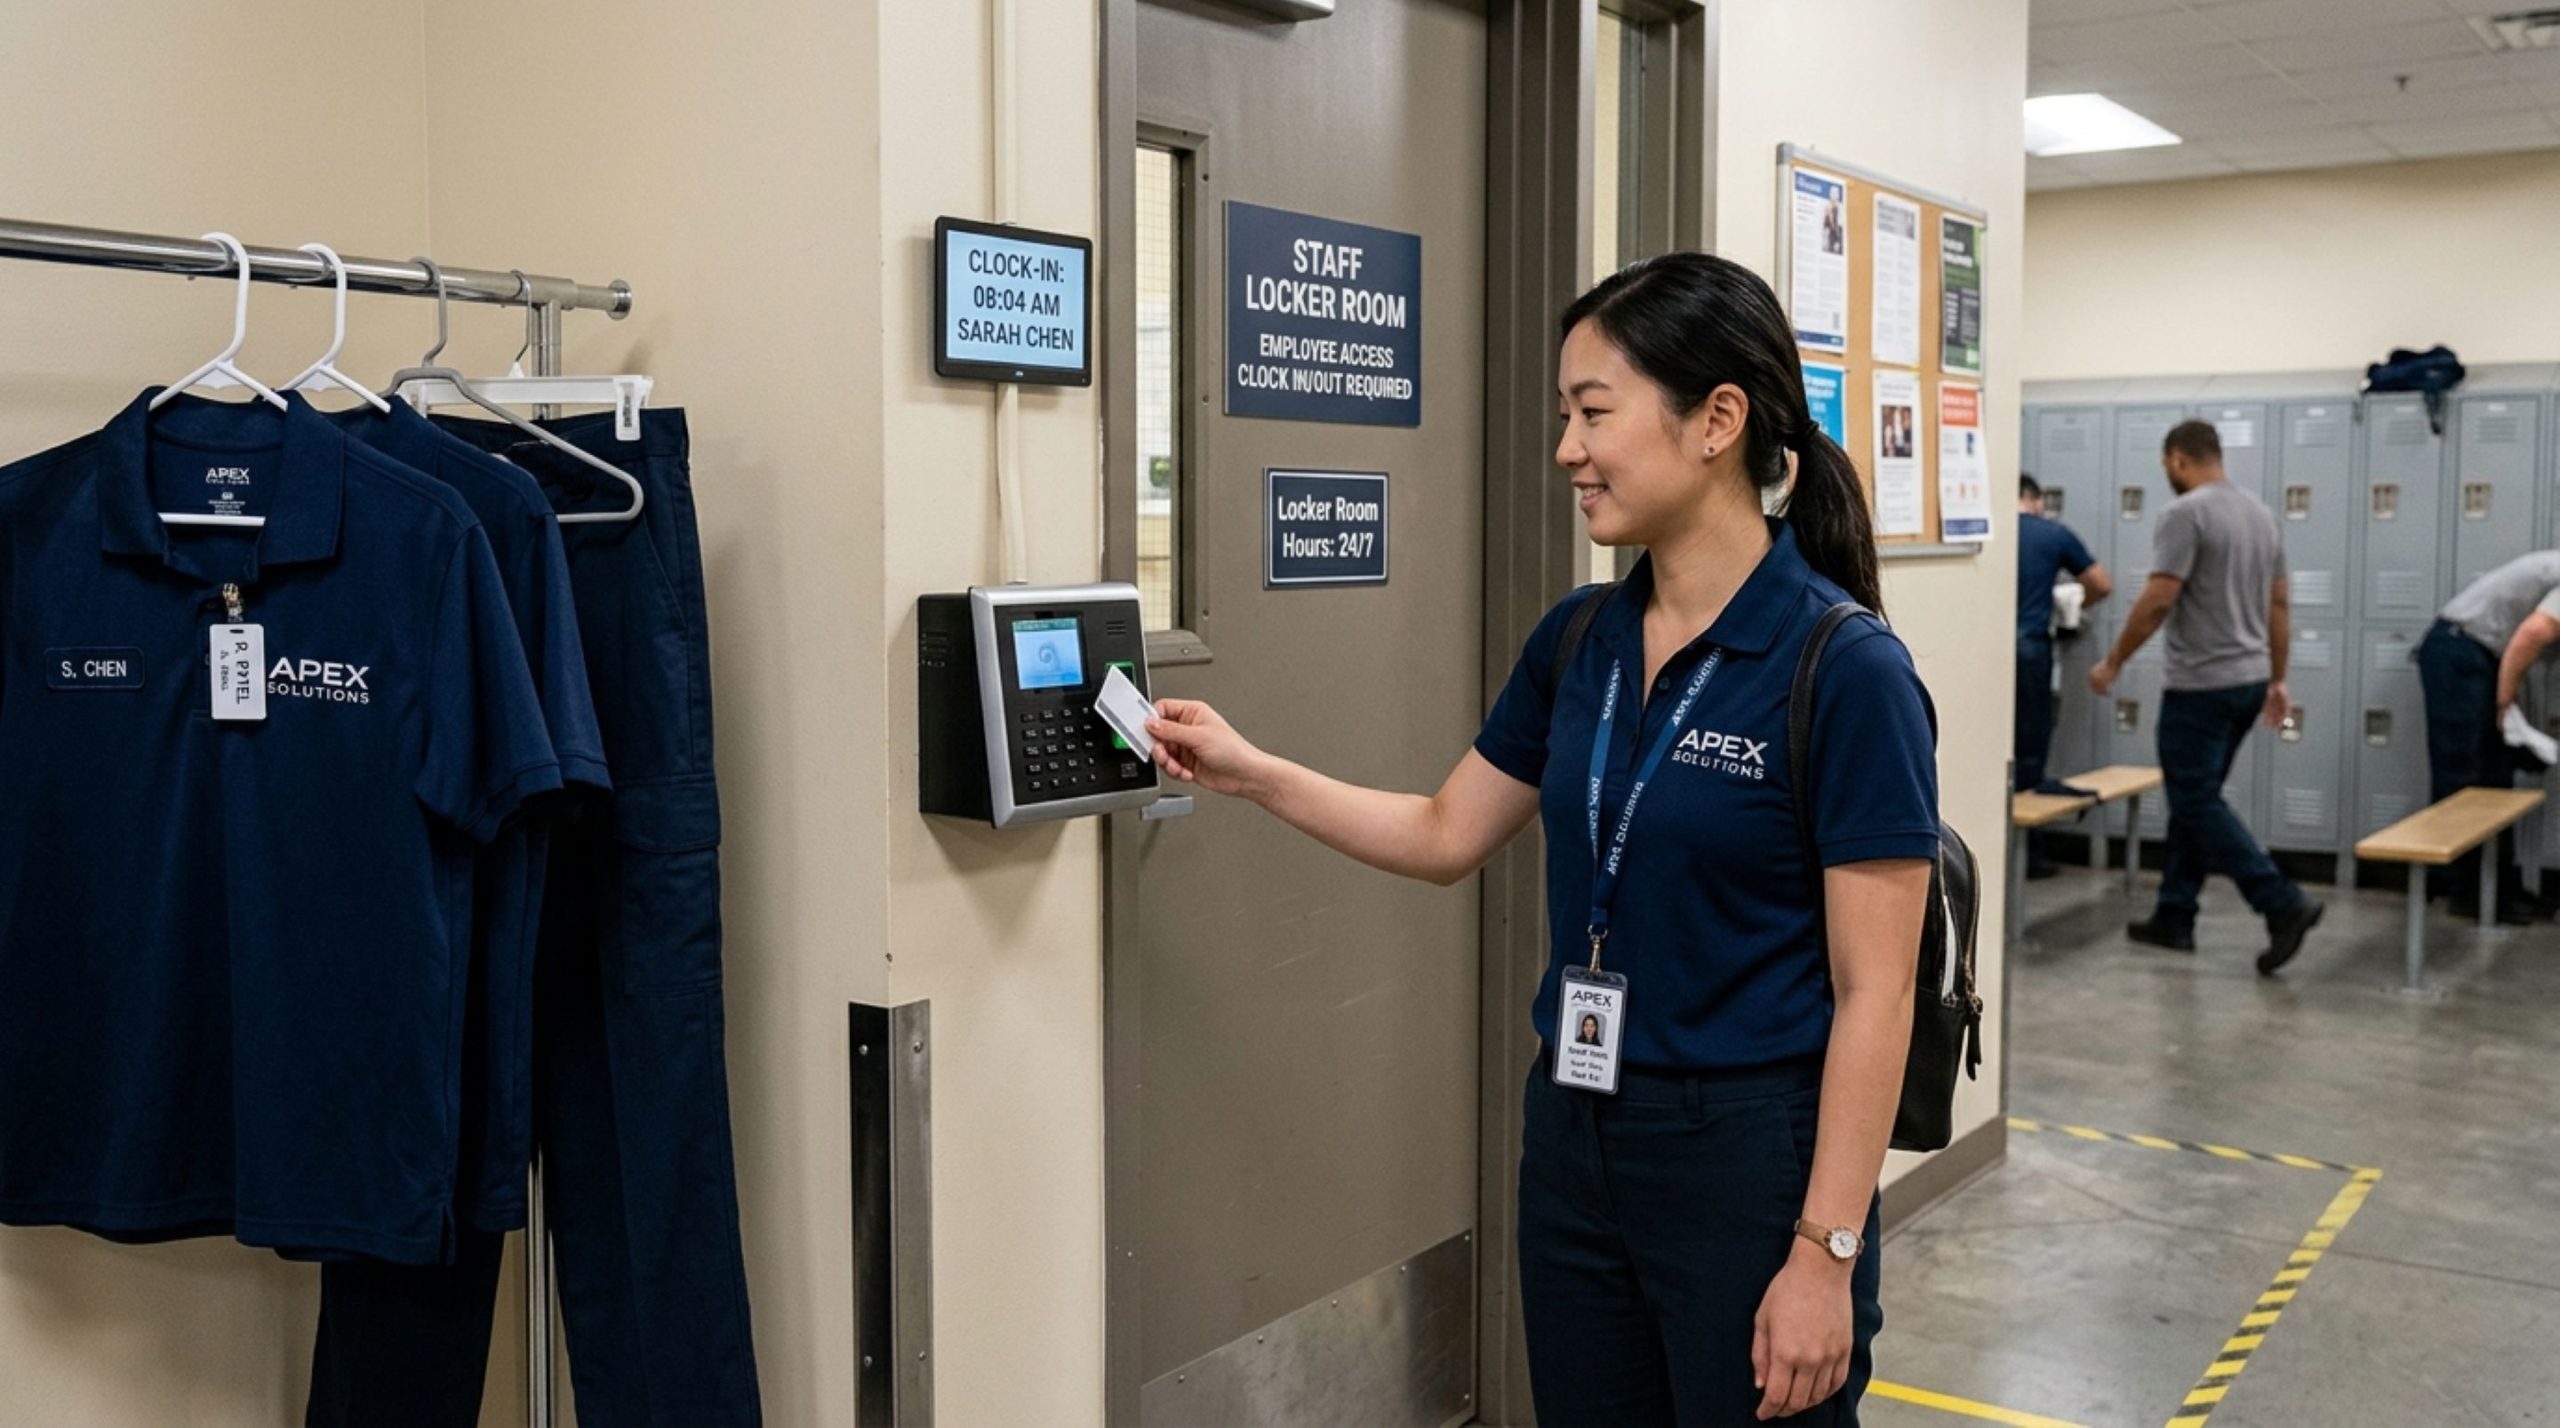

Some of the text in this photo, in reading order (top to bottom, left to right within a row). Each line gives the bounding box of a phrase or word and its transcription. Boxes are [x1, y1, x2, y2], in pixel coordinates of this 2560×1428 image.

[968, 249, 1065, 283] CLOCK-IN:
[1293, 238, 1363, 280] STAFF
[1030, 292, 1060, 317] AM
[1246, 274, 1407, 329] LOCKER ROOM
[958, 317, 1074, 351] SARAH CHEN
[1259, 333, 1394, 368] EMPLOYEE ACCESS
[1238, 363, 1412, 401] CLOCK IN/OUT REQUIRED
[206, 467, 250, 480] APEX
[1278, 493, 1379, 521] Locker Room
[1282, 532, 1374, 558] Hours: 24/7
[61, 660, 127, 679] S. CHEN
[268, 656, 370, 690] APEX
[267, 680, 370, 705] SOLUTIONS
[1677, 728, 1768, 765] APEX
[1671, 749, 1765, 780] SOLUTIONS
[1571, 990, 1612, 1008] APEX
